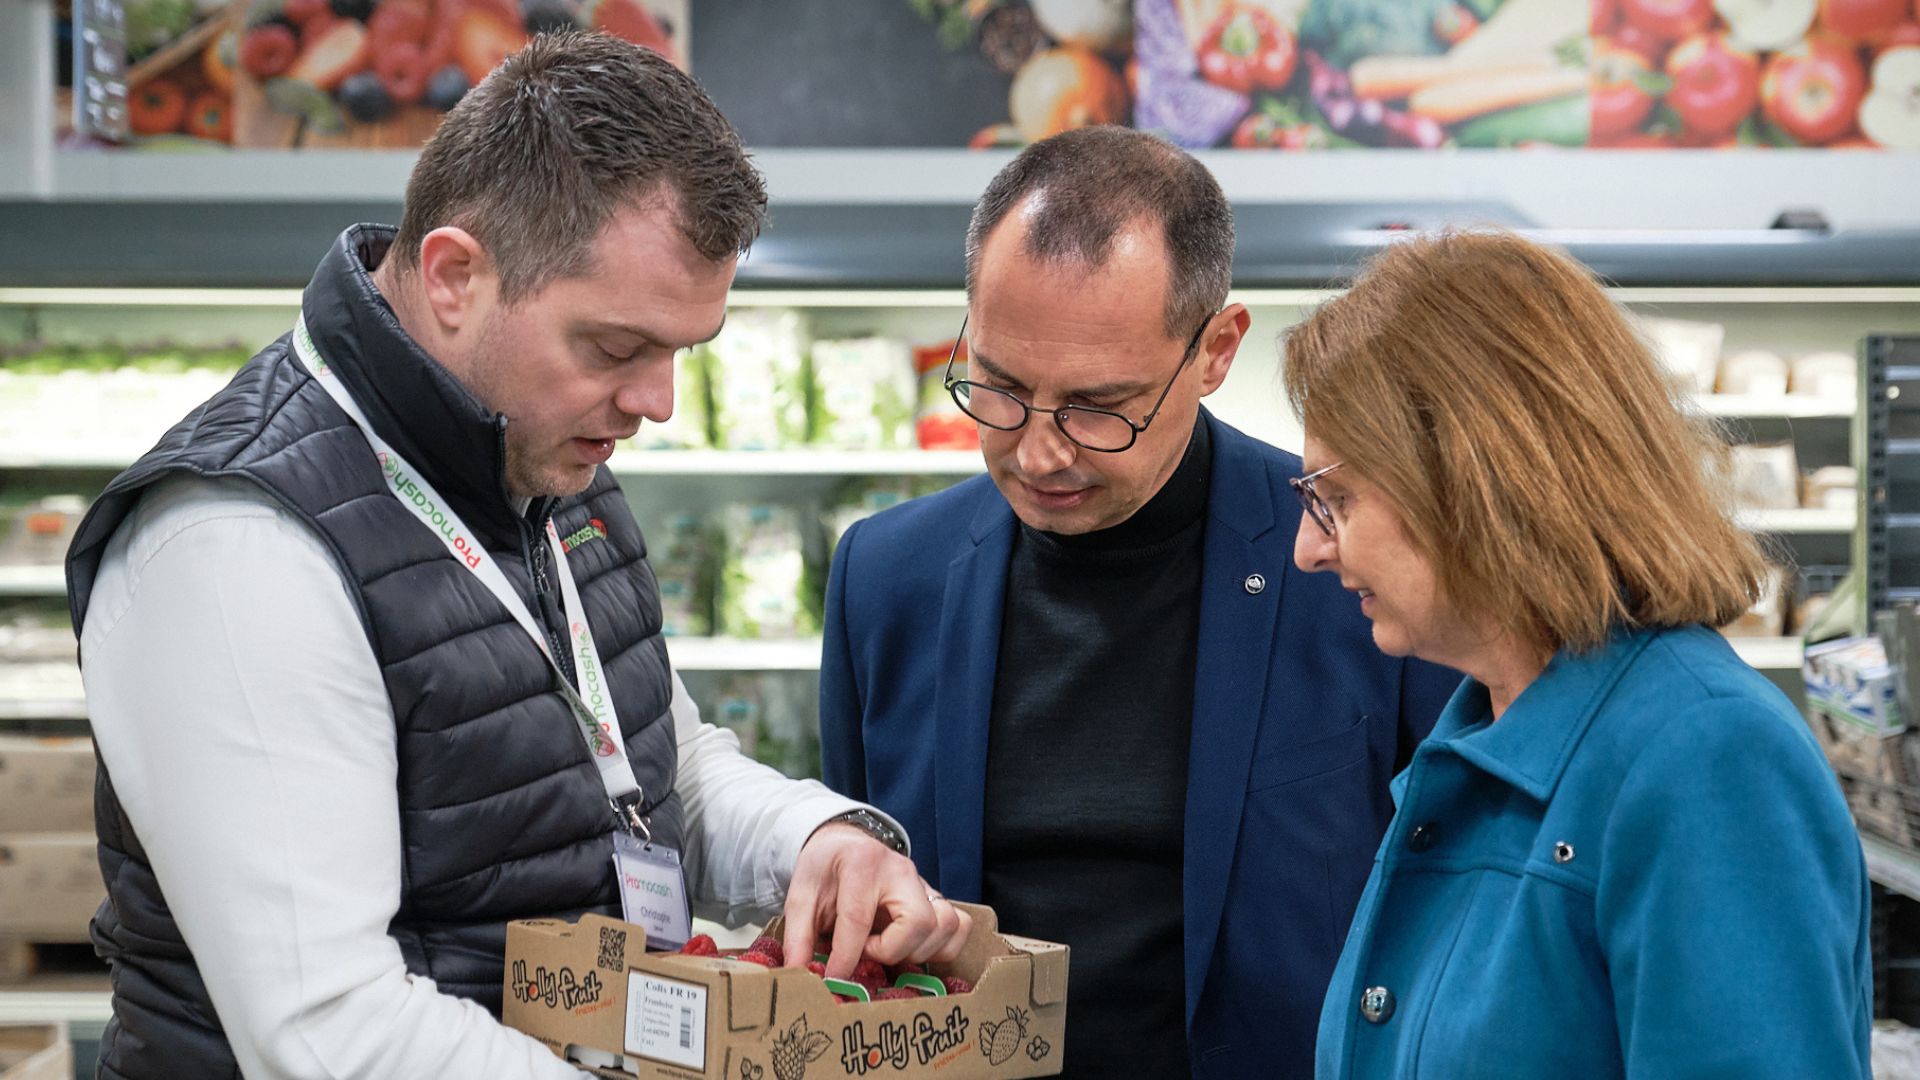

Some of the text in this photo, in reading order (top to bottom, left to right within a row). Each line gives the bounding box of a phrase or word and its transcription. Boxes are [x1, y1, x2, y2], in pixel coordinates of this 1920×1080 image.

[394, 472, 481, 569] Promocash
[579, 647, 611, 733] omocash
[624, 872, 673, 899] Promocash
[512, 959, 603, 1010] Holly fruit
[645, 980, 697, 1000] Colis FR 19
[841, 1004, 970, 1076] Holly fruit
